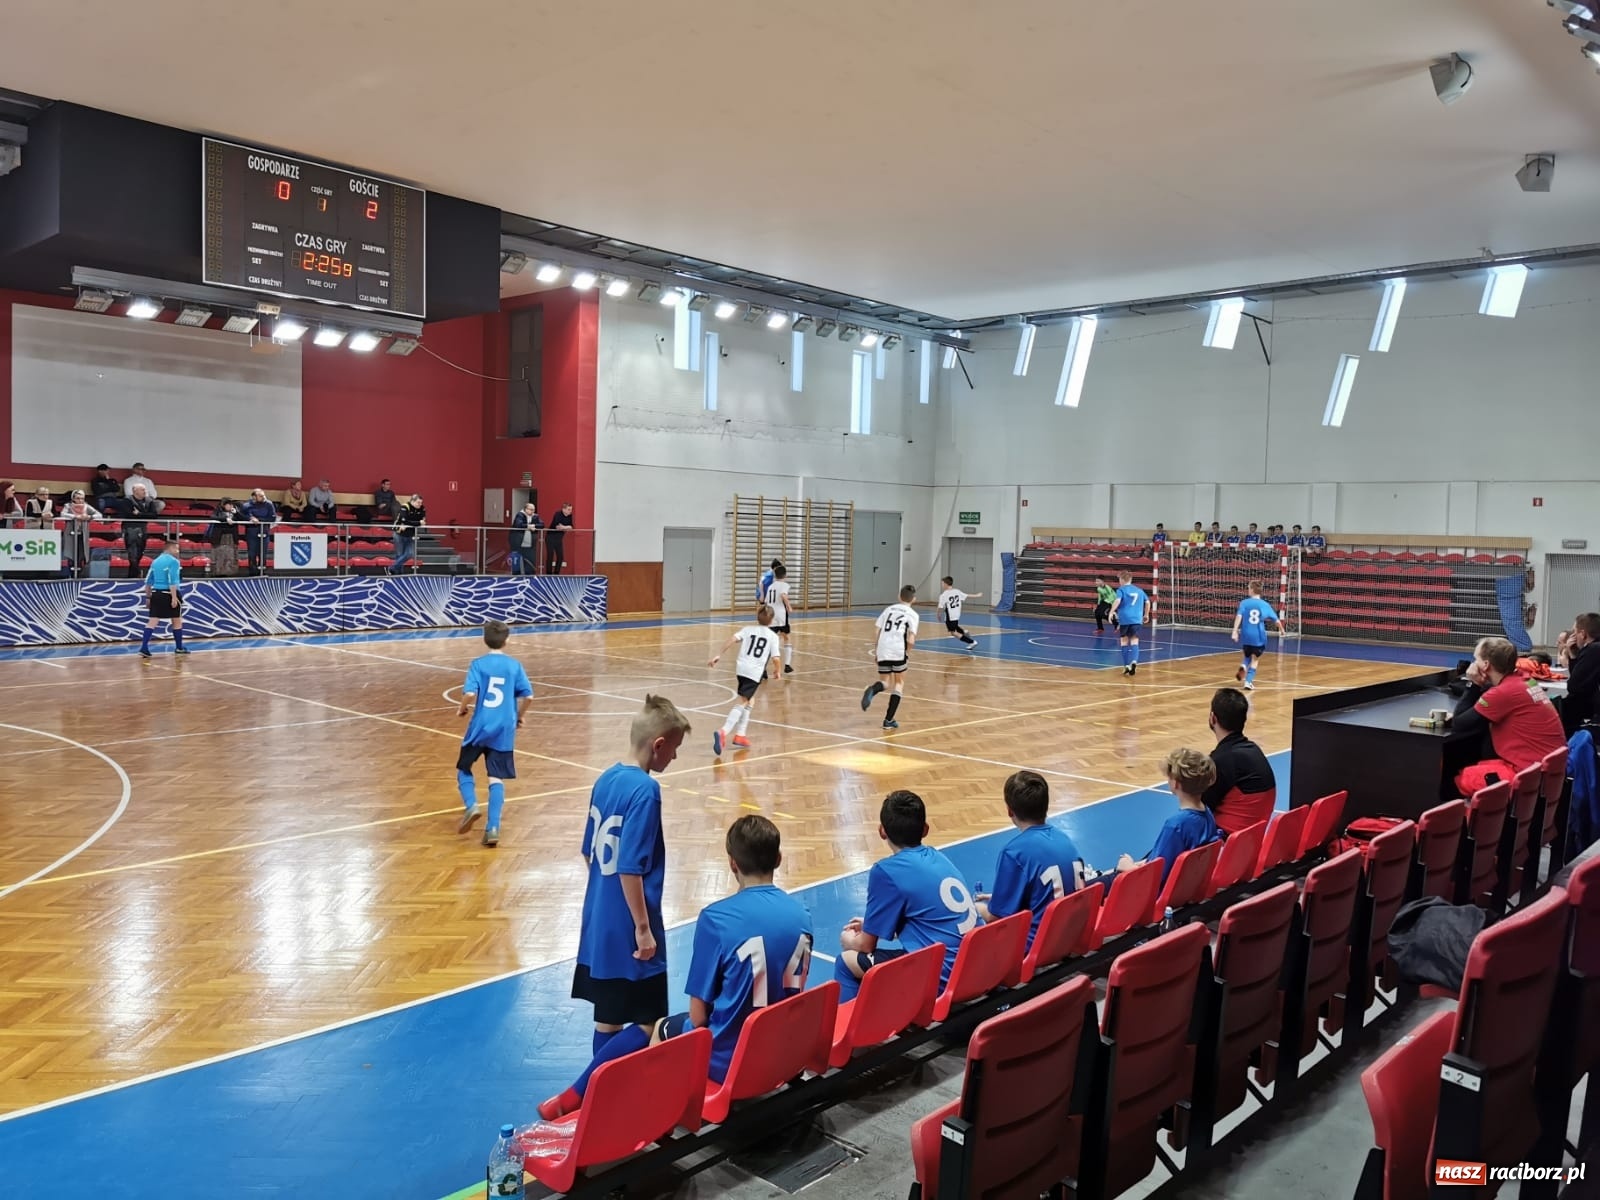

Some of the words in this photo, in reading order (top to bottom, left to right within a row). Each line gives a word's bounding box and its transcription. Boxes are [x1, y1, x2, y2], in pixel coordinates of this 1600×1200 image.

[248, 155, 300, 180] GOSPODARZE
[278, 181, 291, 200] 0
[349, 178, 379, 198] GOŚCIE
[366, 200, 378, 219] 2
[295, 232, 323, 250] CZAS
[325, 238, 347, 255] GRY
[306, 278, 322, 288] TIME
[323, 281, 337, 289] OUT
[769, 589, 777, 604] 11
[1129, 593, 1139, 606] 7
[1248, 609, 1260, 625] 8
[746, 634, 768, 658] 18
[483, 676, 506, 708] 5
[939, 876, 977, 936] 9
[736, 933, 812, 1008] 14
[1456, 1072, 1465, 1085] 2
